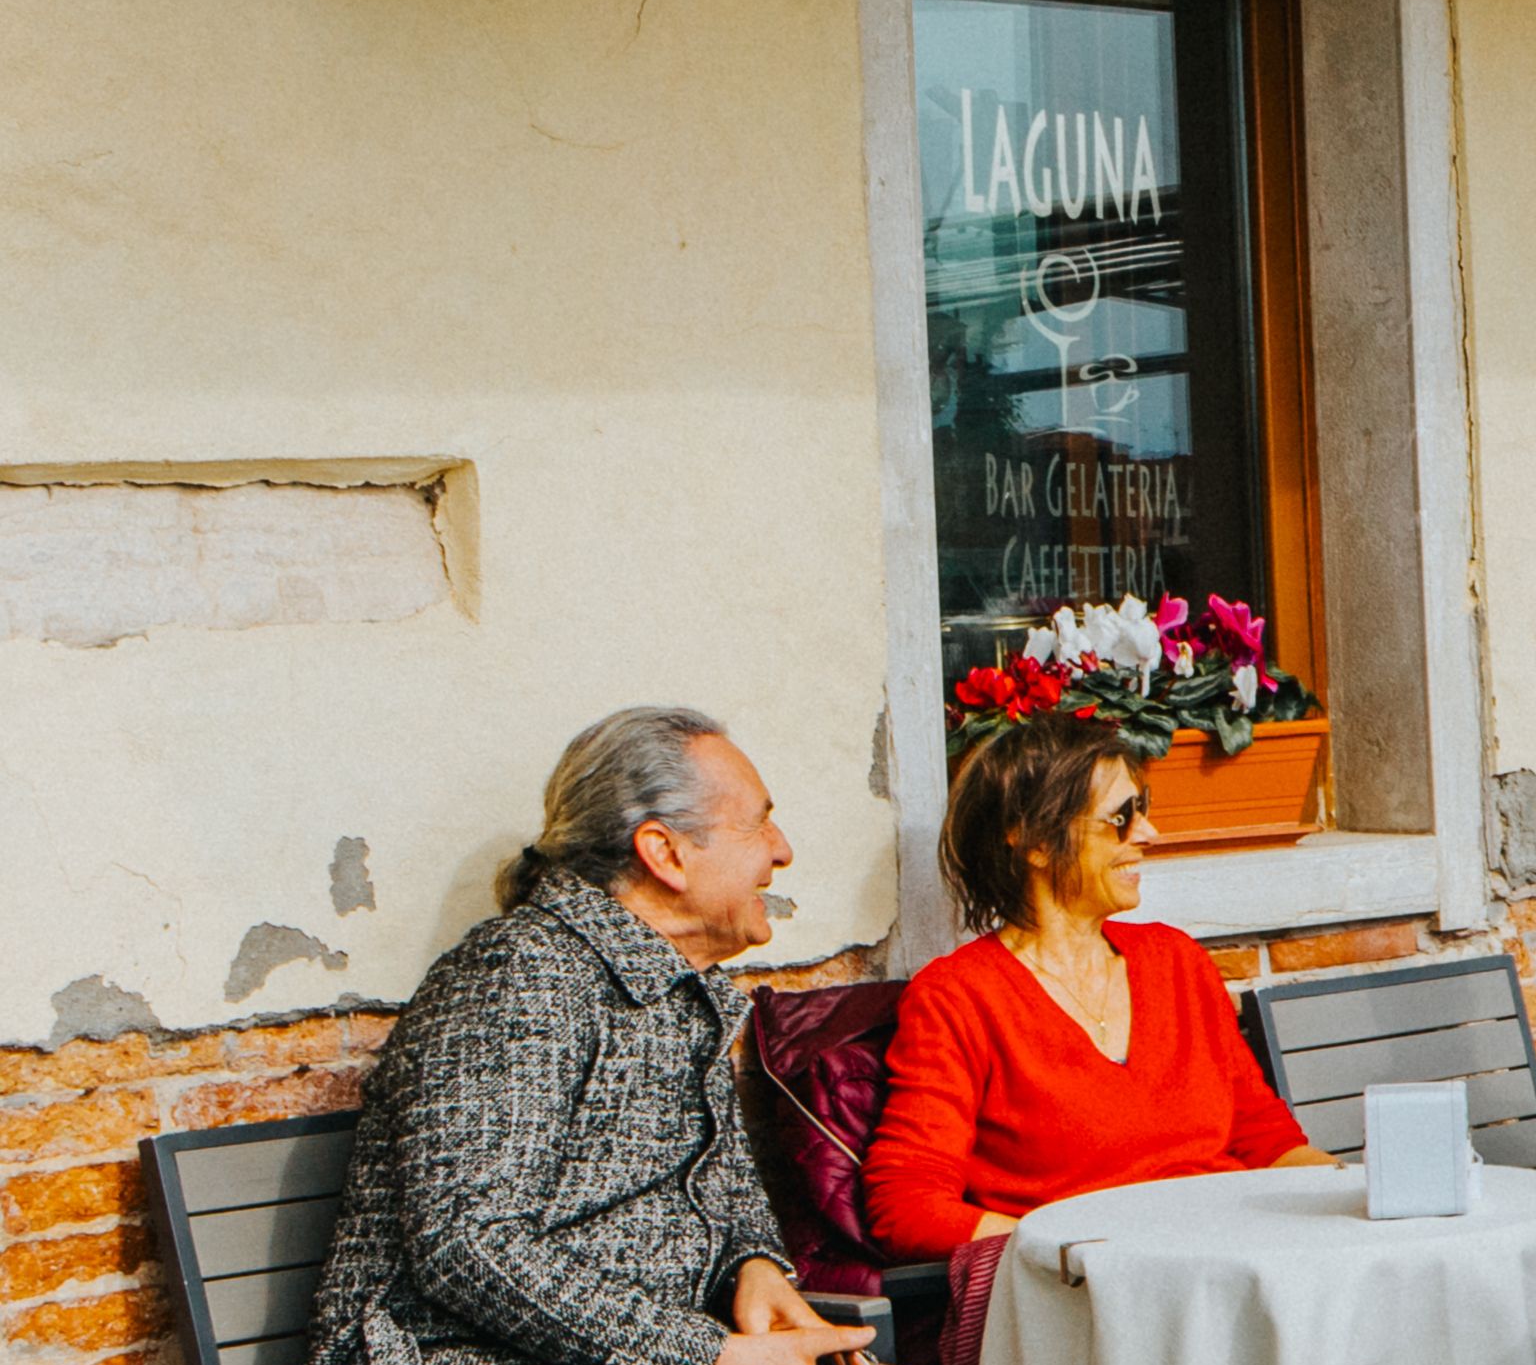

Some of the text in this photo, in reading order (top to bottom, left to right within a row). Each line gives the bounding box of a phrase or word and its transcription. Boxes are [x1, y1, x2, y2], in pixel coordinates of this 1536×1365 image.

[962, 88, 1162, 226] LAGUNA
[985, 452, 1181, 521] BAR GELATERIA
[1002, 535, 1166, 600] CAFFETTERIA
